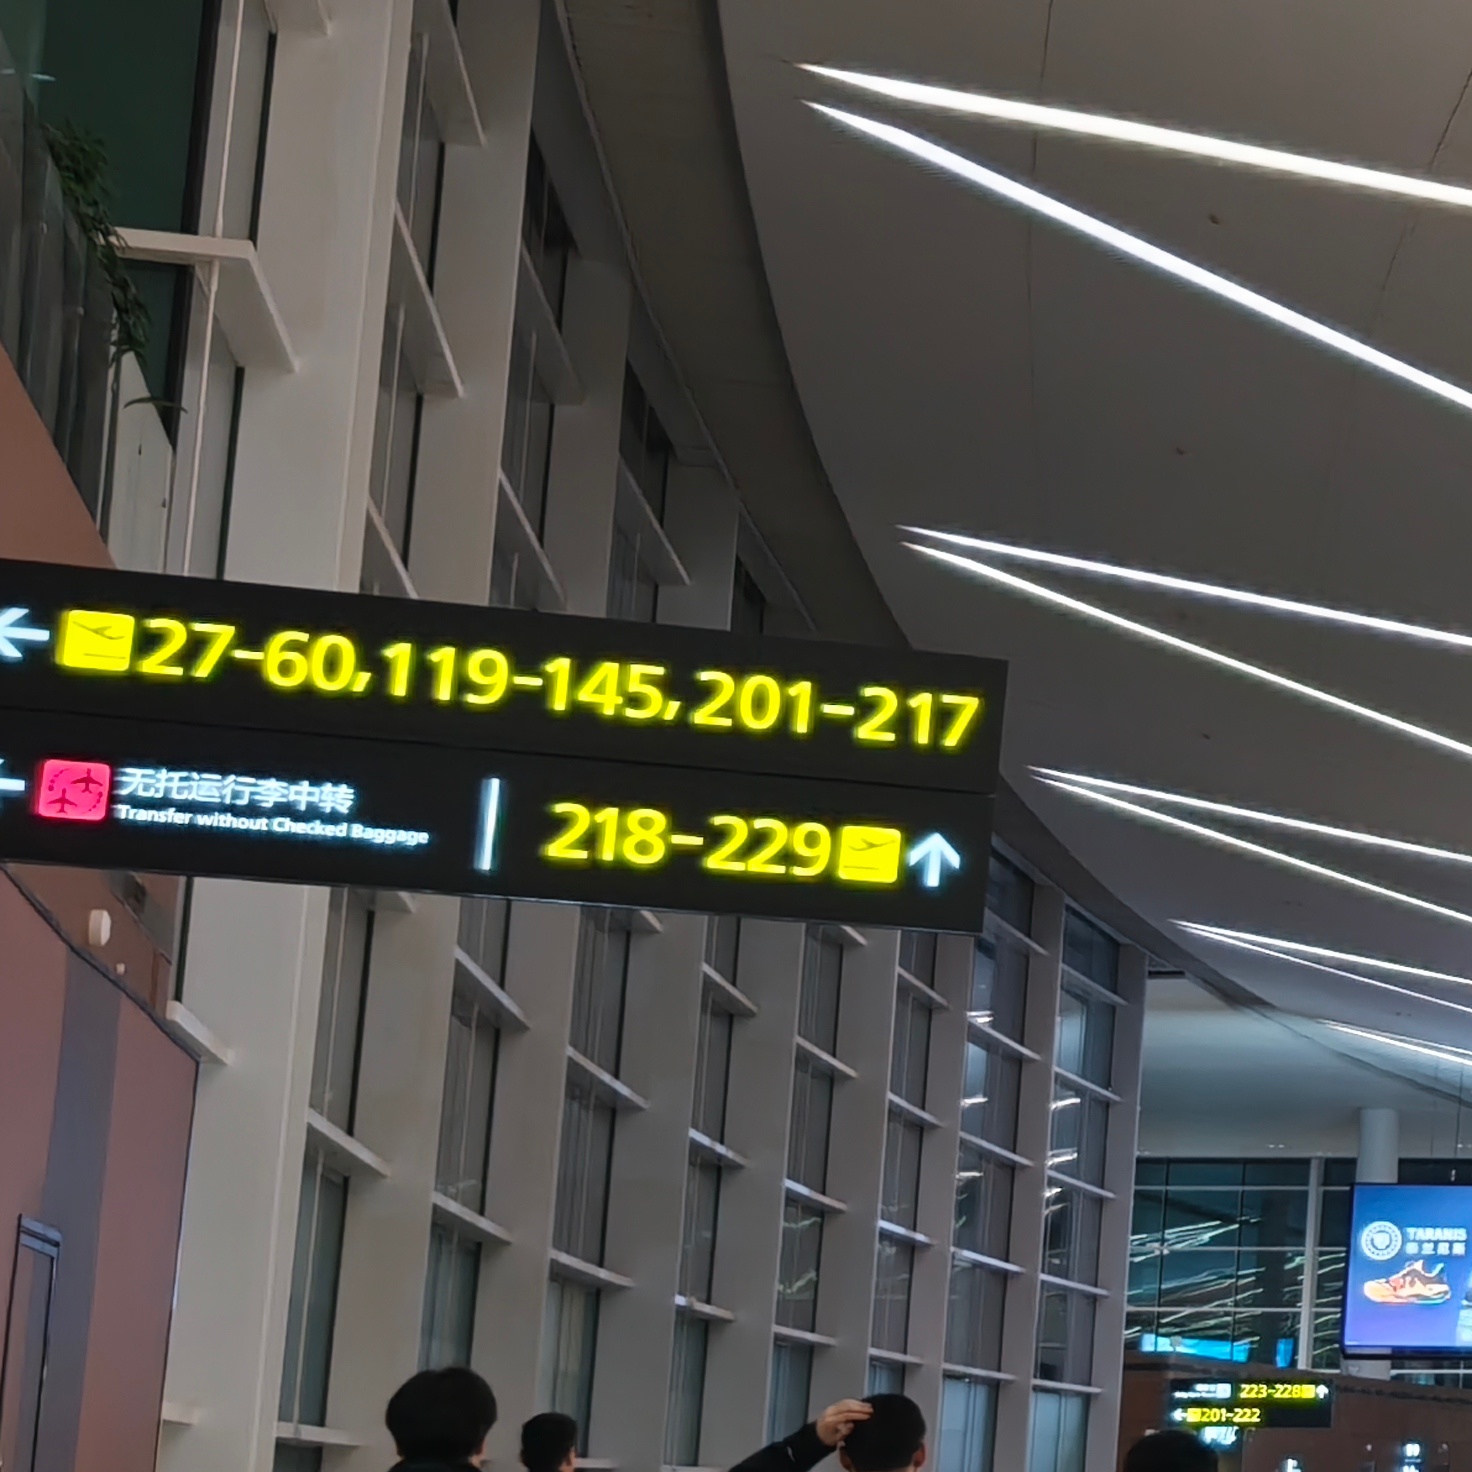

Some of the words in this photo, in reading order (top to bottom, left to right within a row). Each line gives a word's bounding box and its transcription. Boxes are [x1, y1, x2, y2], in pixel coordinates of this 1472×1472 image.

[117, 767, 355, 814] 无托运行李中转
[117, 804, 191, 826] Transfer
[197, 812, 269, 831] without
[272, 817, 348, 837] Checked
[351, 823, 430, 846] Baggage
[543, 800, 832, 878] 218-229
